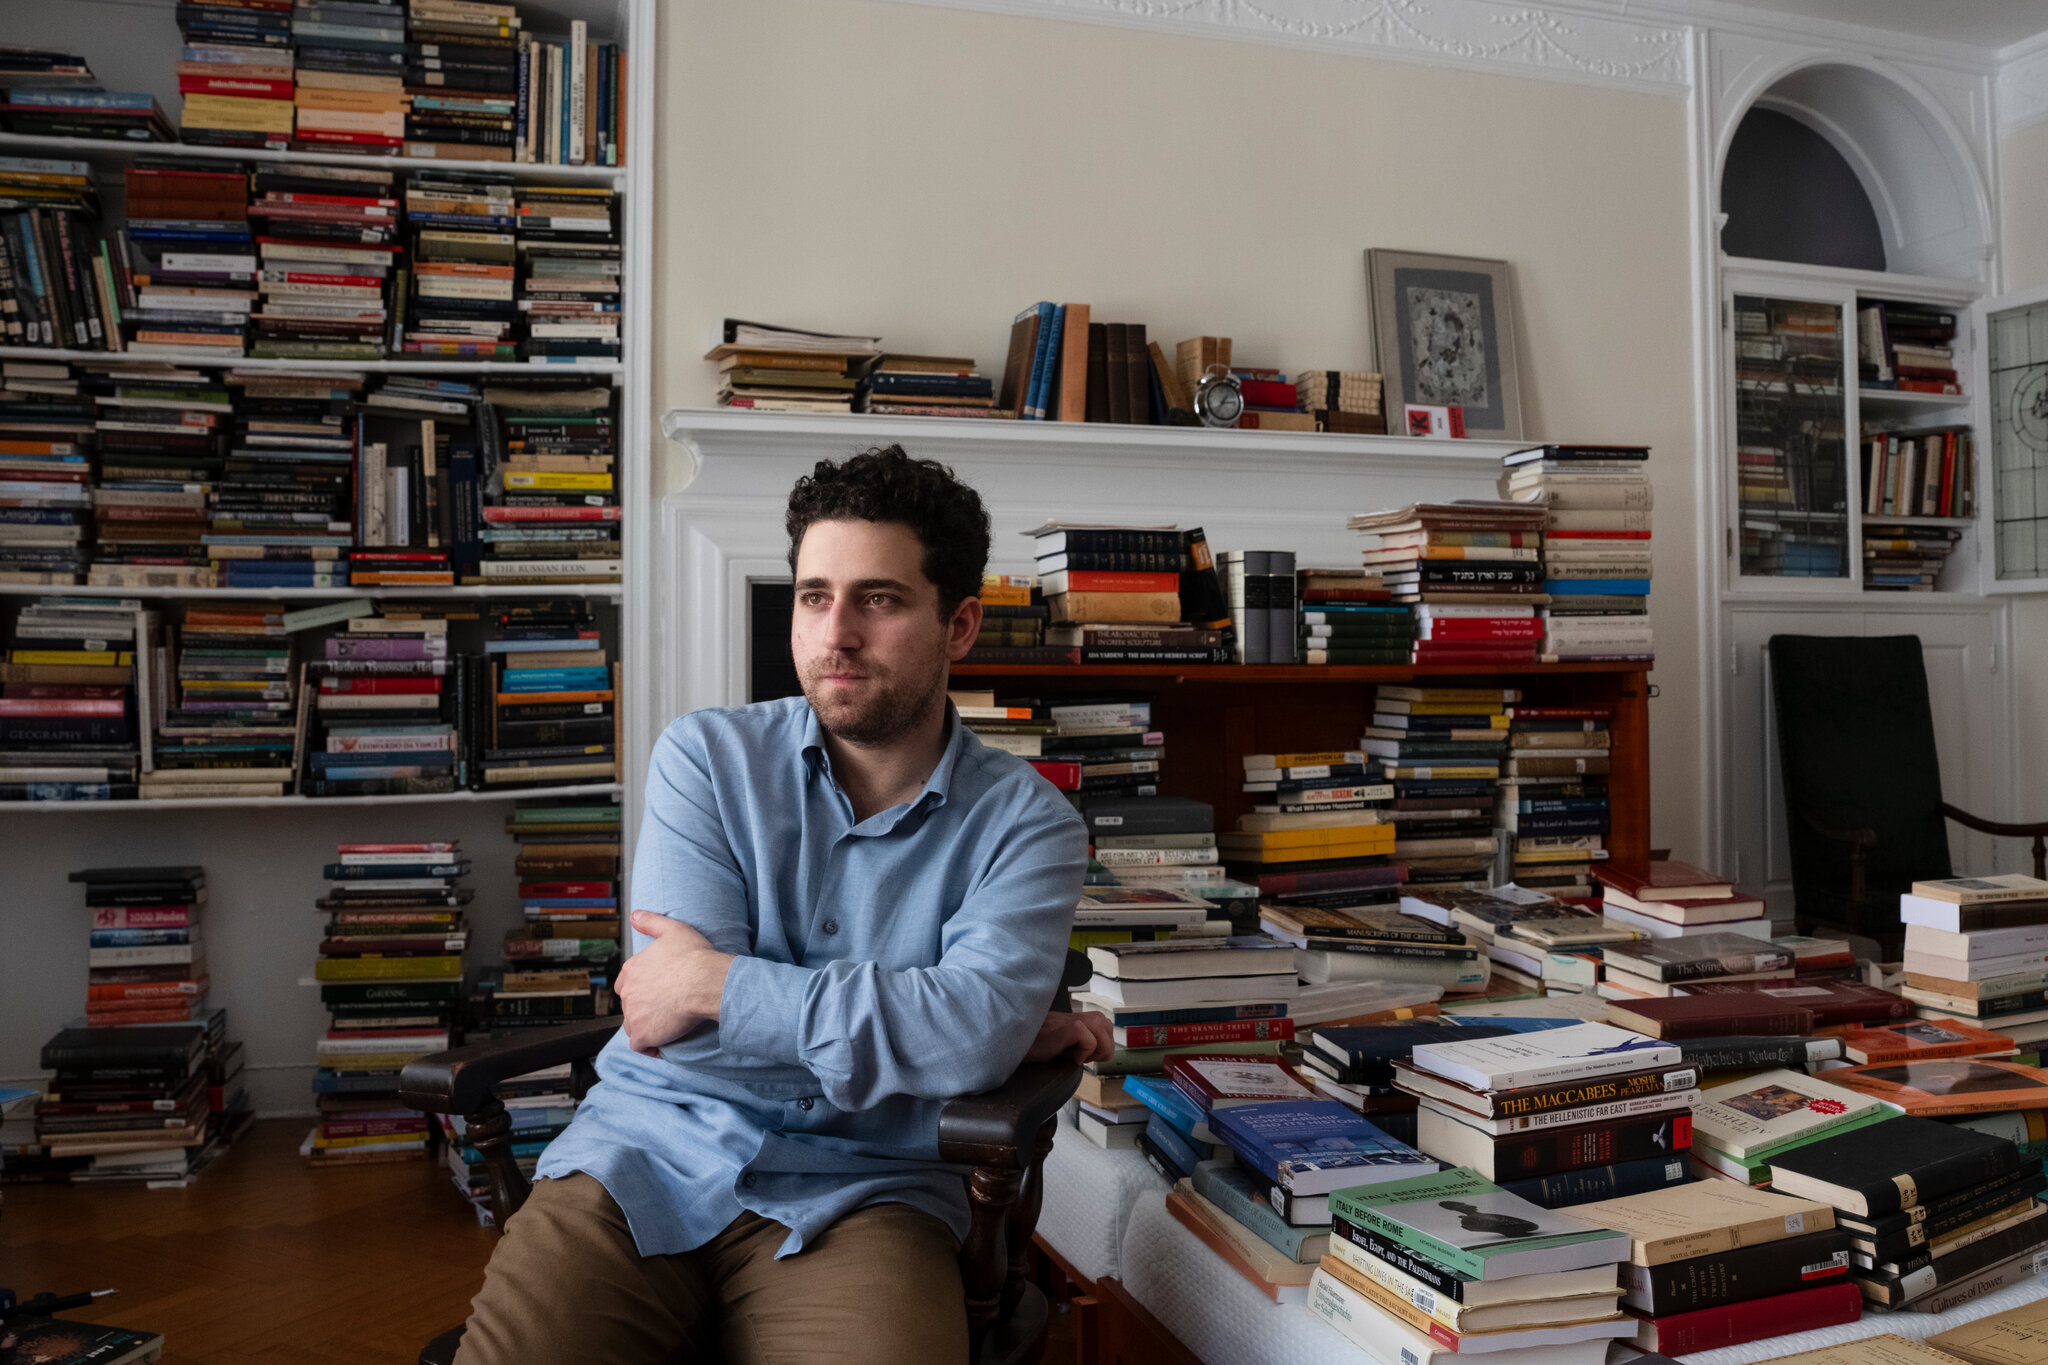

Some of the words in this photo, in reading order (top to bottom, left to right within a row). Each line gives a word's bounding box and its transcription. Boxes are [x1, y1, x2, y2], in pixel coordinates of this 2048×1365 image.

[495, 565, 516, 573] THE
[518, 565, 558, 573] RUSSIAN
[560, 564, 585, 573] ICON
[9, 729, 84, 741] GEOGRAPHY
[1346, 928, 1390, 938] MANUSCRIPTS
[1346, 944, 1377, 952] HISTORICAL
[1675, 964, 1694, 976] The
[1695, 961, 1722, 974] String
[1191, 1024, 1223, 1033] ORANGE
[1227, 1023, 1251, 1031] TREES
[1192, 1033, 1241, 1041] MARRAKESH
[1920, 1049, 1936, 1058] THE
[1938, 1046, 1964, 1056] GREAT
[1627, 1074, 1657, 1088] MOSHE
[1620, 1081, 1665, 1097] PEARLMAN
[1500, 1099, 1531, 1115] THE
[1534, 1083, 1616, 1110] MACCABEES
[1245, 1115, 1339, 1125] SCHOLARSHIP
[1533, 1115, 1549, 1126] THE
[1549, 1108, 1595, 1124] HELLENISTIC
[1596, 1106, 1609, 1117] FAR
[1610, 1102, 1628, 1115] EAST
[1307, 1118, 1364, 1127] HISTORY
[1807, 1122, 1826, 1136] NOTION
[1827, 1119, 1834, 1129] OF
[1355, 1191, 1389, 1202] ITALY
[1392, 1183, 1443, 1198] BEFORE
[1444, 1178, 1484, 1193] ROME
[1335, 1199, 1353, 1216] ITALY
[1354, 1208, 1381, 1228] BEFORE
[1382, 1220, 1404, 1238] ROME
[1352, 1253, 1373, 1275] SHIFTING
[1374, 1266, 1387, 1283] LINES
[1388, 1274, 1394, 1286] IN
[1394, 1277, 1405, 1294] THE
[1386, 1251, 1396, 1263] AND
[1408, 1258, 1442, 1287] PALESTINIANS
[1719, 1263, 1727, 1297] CENTURY
[1930, 1291, 1967, 1315] Cultures
[1967, 1286, 1977, 1300] of
[1978, 1275, 2005, 1295] Power
